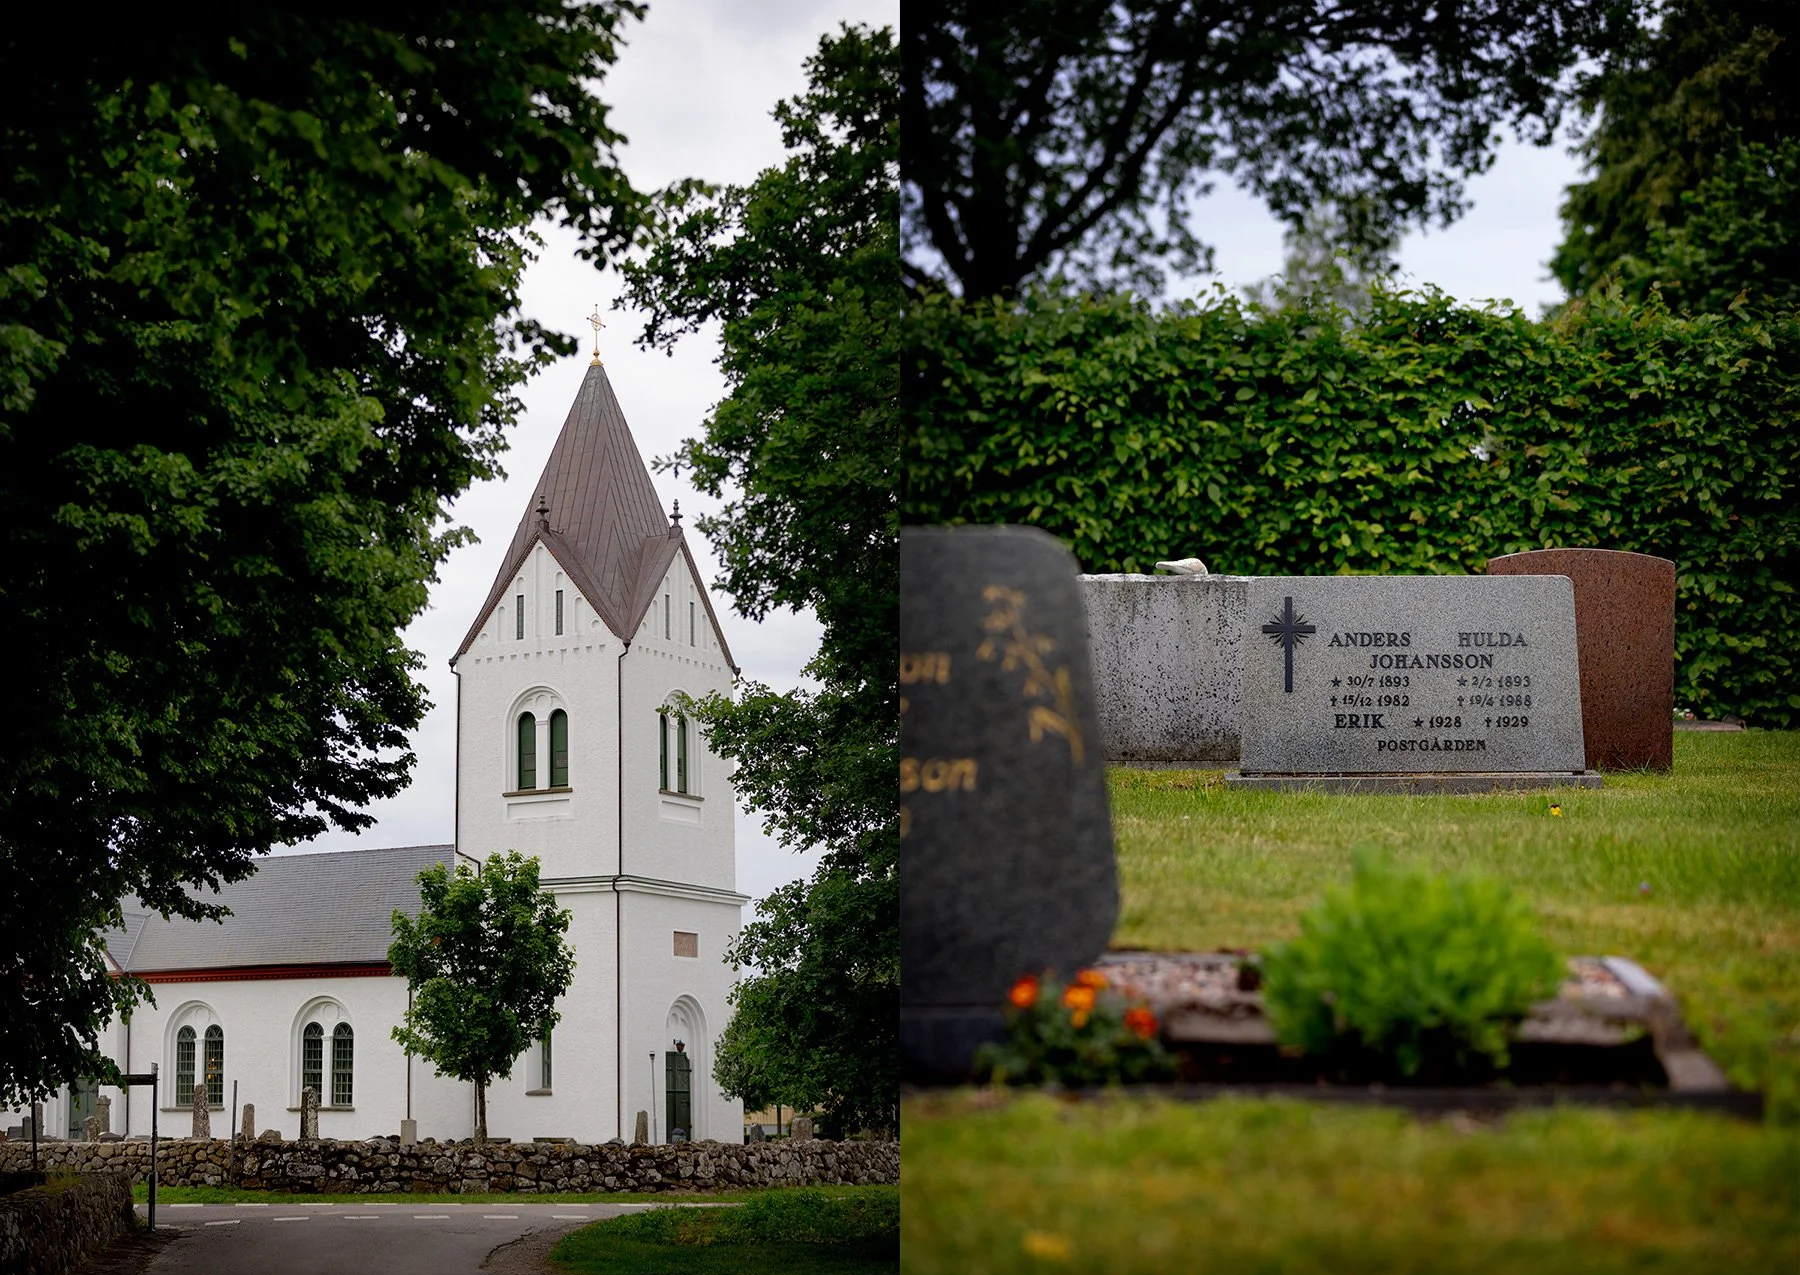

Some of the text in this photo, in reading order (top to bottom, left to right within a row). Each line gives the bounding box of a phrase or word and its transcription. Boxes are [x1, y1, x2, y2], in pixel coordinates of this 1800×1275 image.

[1328, 632, 1528, 647] ANDERS HULDA
[1370, 654, 1494, 669] JOHANSSON
[1379, 676, 1410, 687] 1893
[1498, 676, 1531, 687] 1893
[1377, 695, 1410, 707] 1982
[1500, 695, 1532, 706] 1988
[1334, 714, 1529, 728] ERIK 1928 1929
